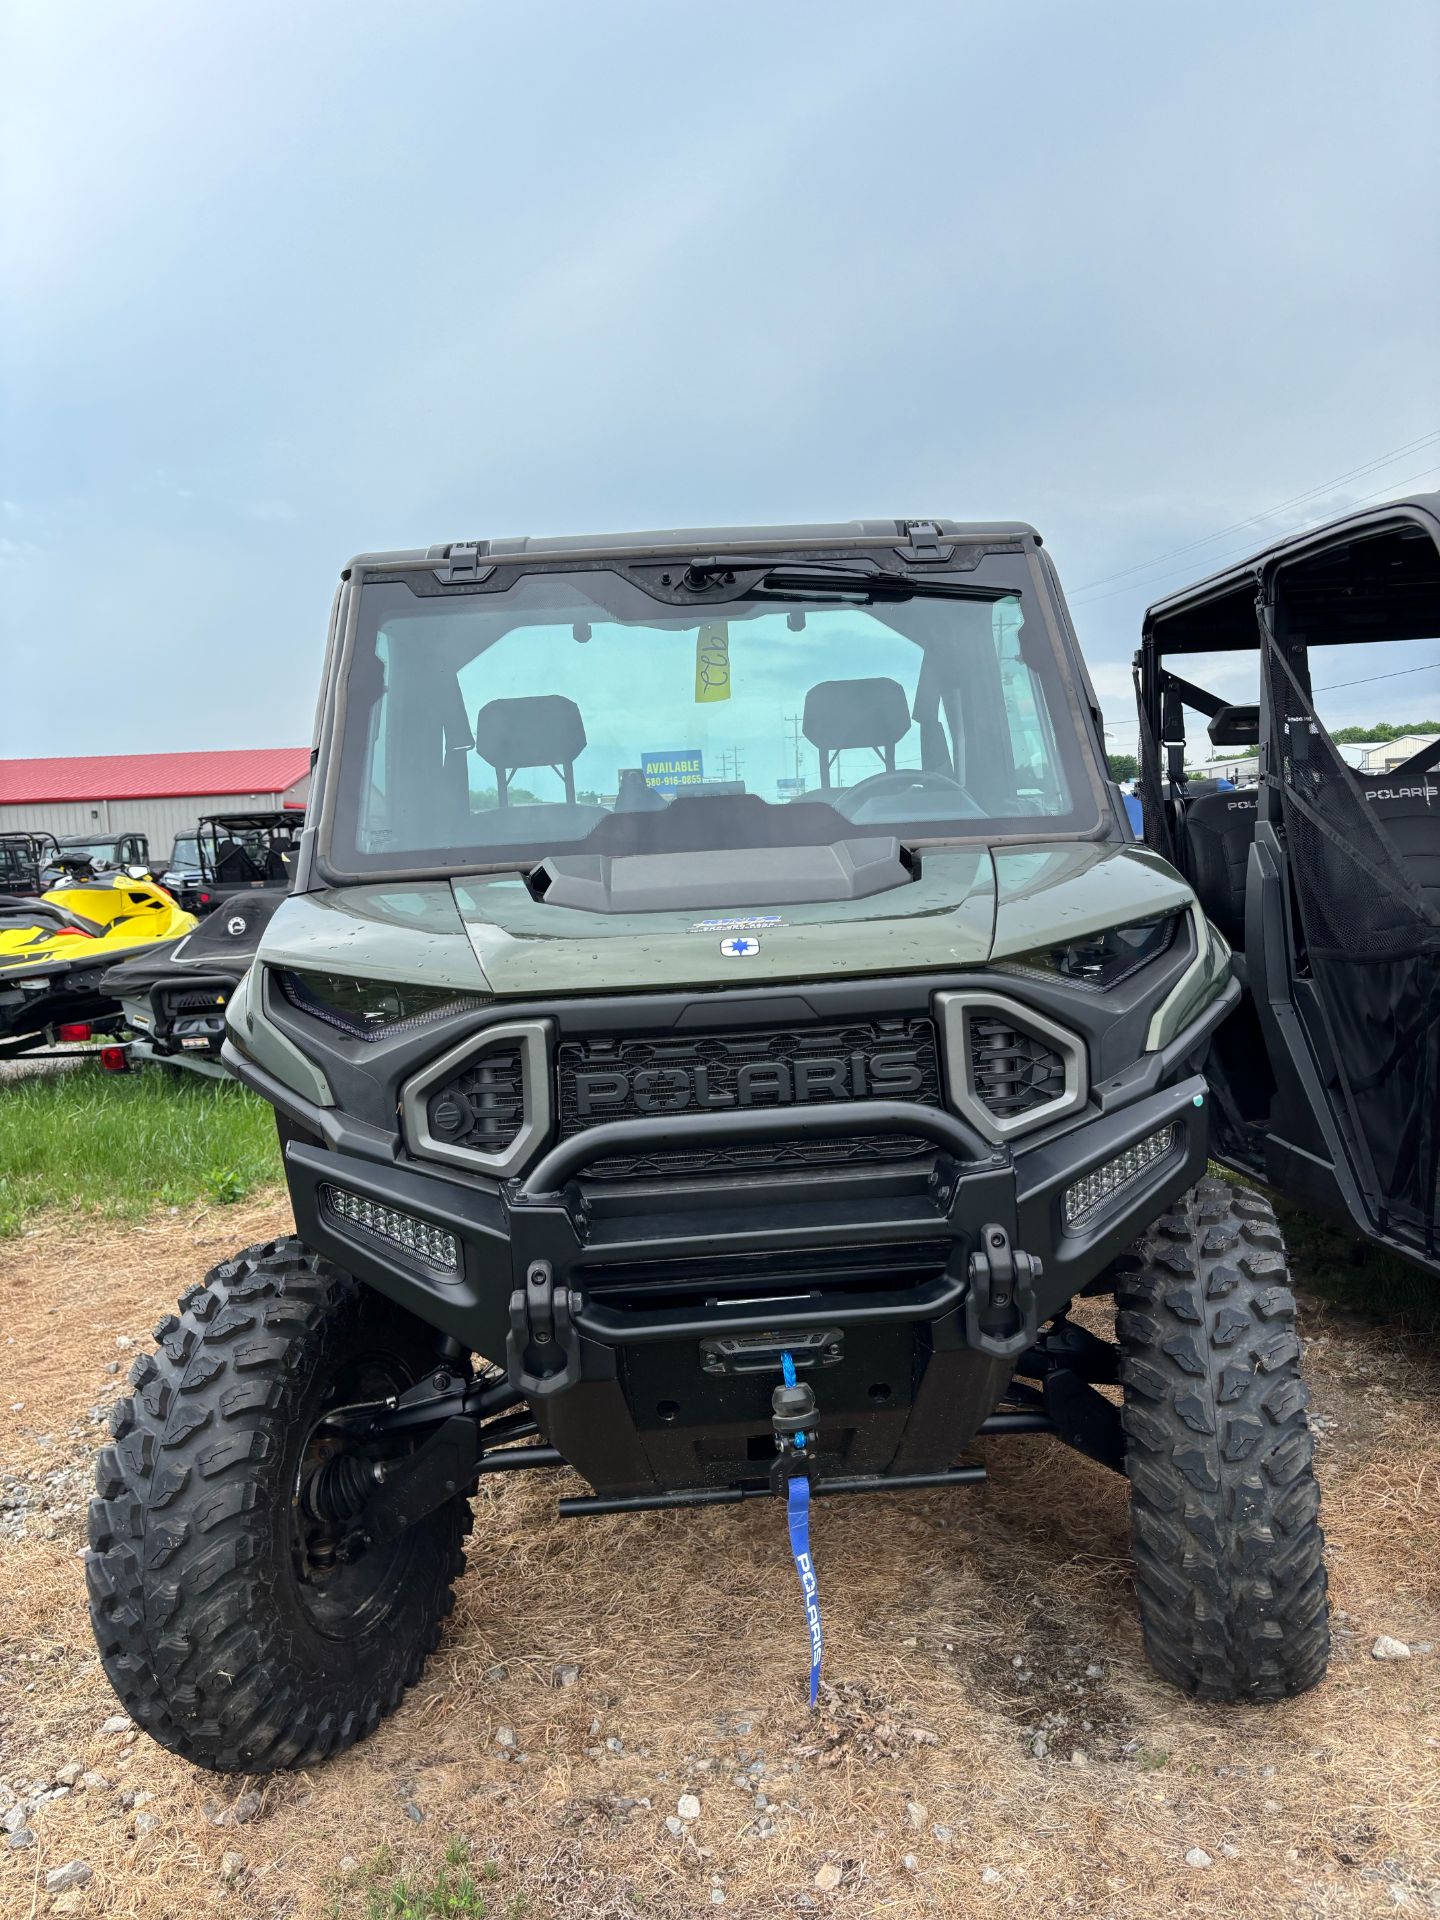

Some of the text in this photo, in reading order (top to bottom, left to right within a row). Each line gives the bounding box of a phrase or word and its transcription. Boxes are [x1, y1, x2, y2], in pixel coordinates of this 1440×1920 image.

[646, 760, 700, 774] AVAILABLE
[1365, 786, 1438, 801] POLARIS
[575, 1051, 924, 1115] POLARIS
[797, 1552, 822, 1667] POLARIS
